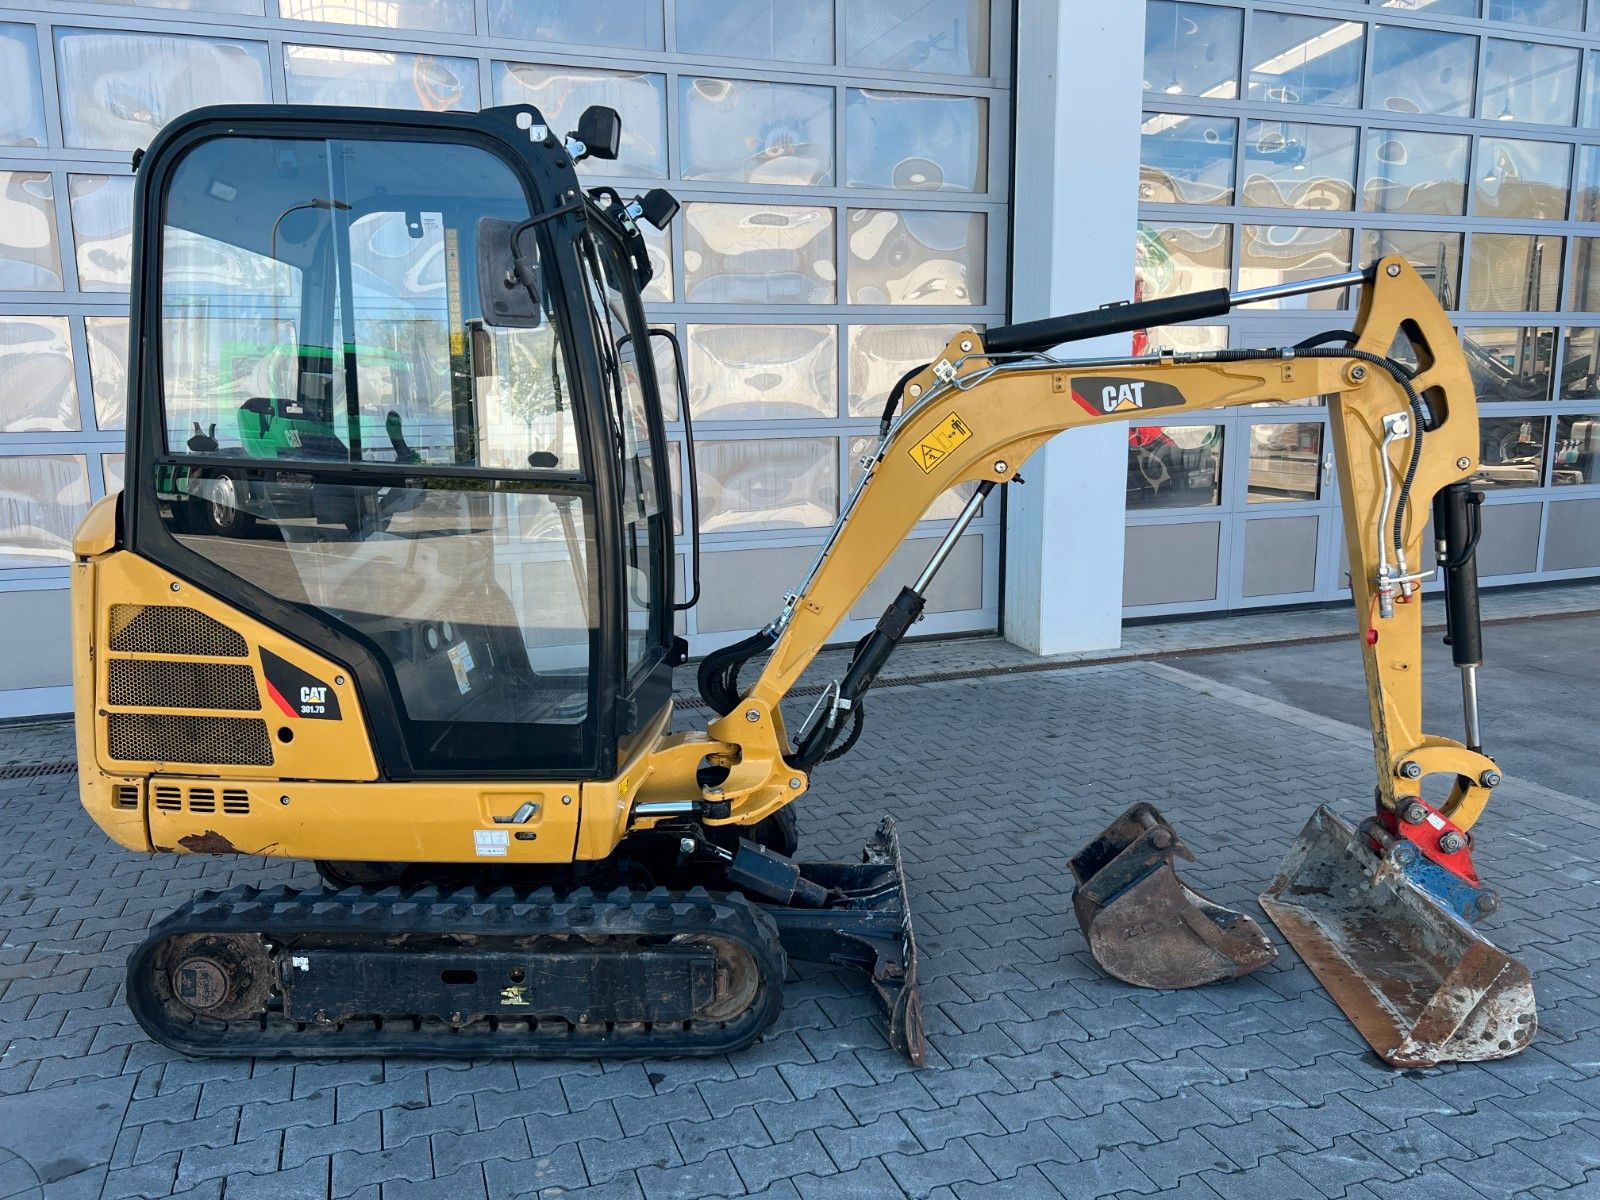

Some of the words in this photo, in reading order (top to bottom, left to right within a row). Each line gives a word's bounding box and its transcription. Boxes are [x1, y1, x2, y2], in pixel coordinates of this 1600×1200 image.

[1102, 381, 1145, 412] CAT
[300, 686, 327, 704] CAT
[300, 705, 325, 714] 301.7D
